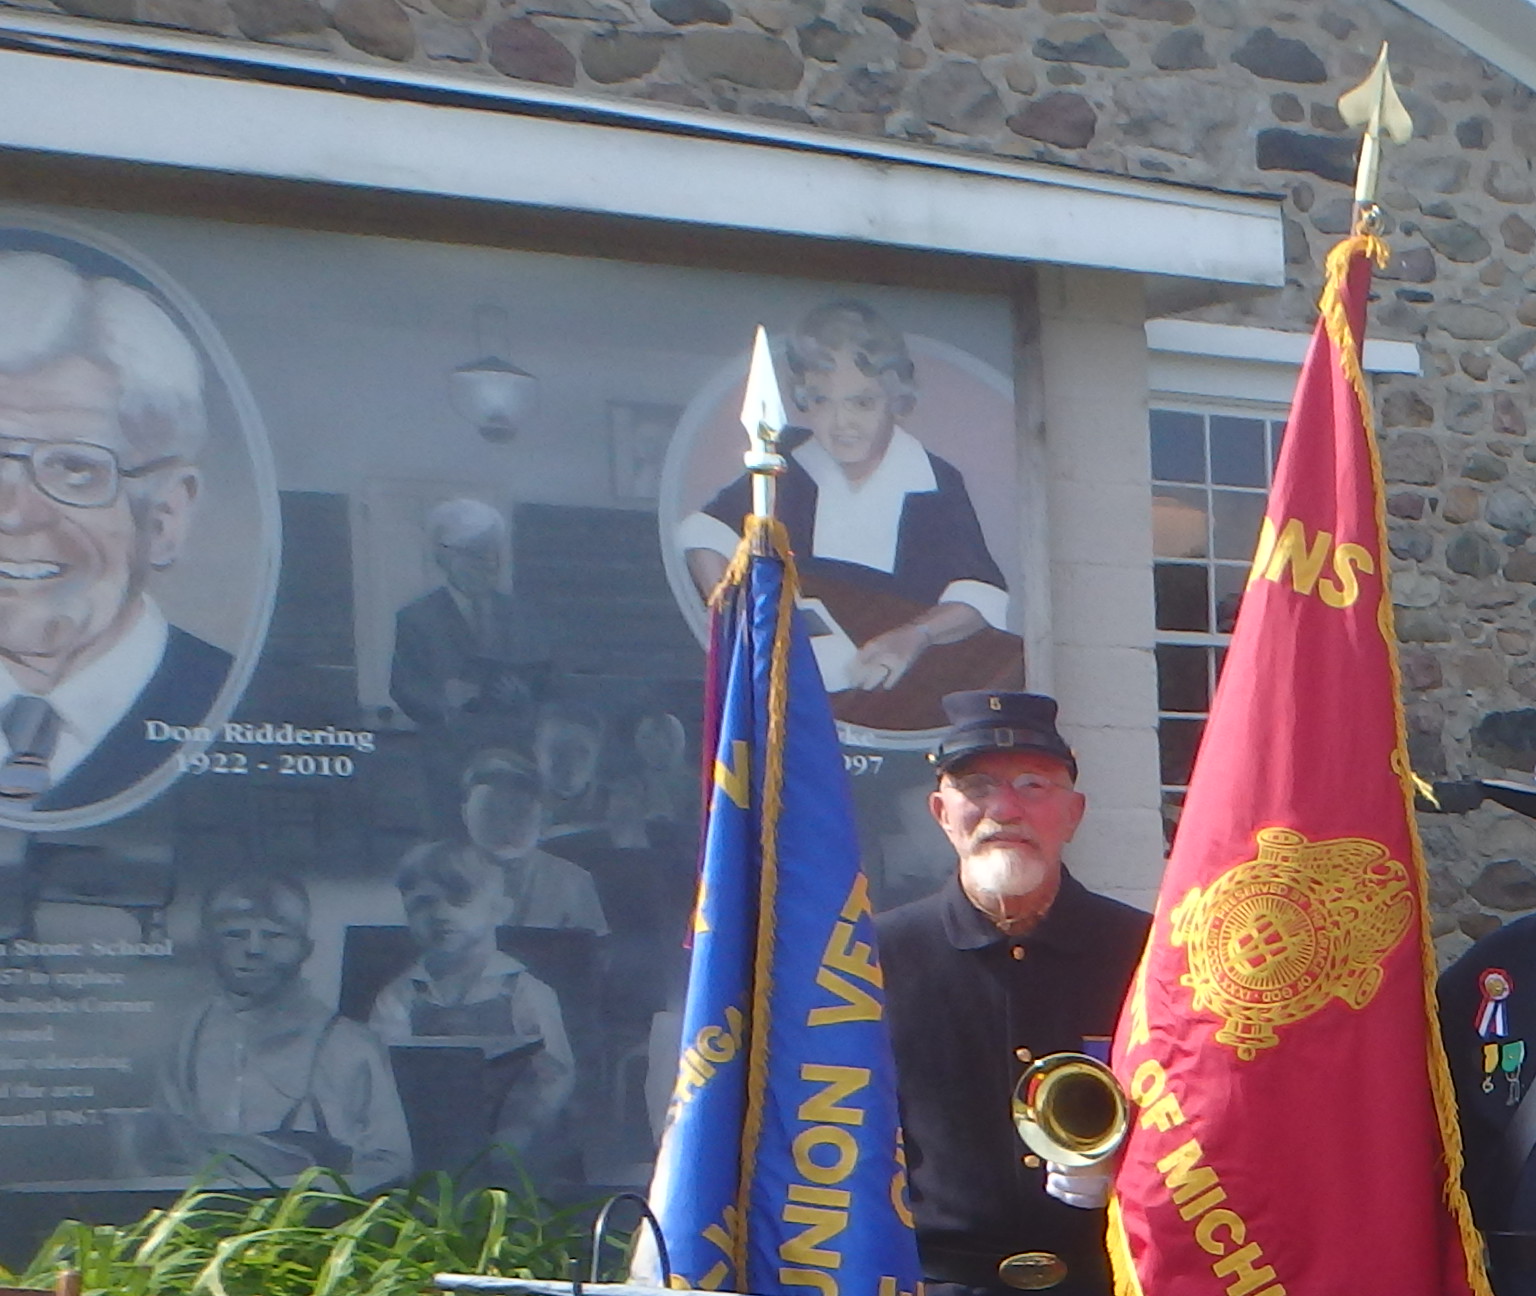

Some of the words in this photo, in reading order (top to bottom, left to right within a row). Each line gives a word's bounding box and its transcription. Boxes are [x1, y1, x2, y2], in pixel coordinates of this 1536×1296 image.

[144, 719, 211, 742] Don
[223, 722, 376, 753] Riddering
[177, 750, 248, 775] 1922
[278, 754, 355, 777] 2010
[1130, 1058, 1187, 1133] OF
